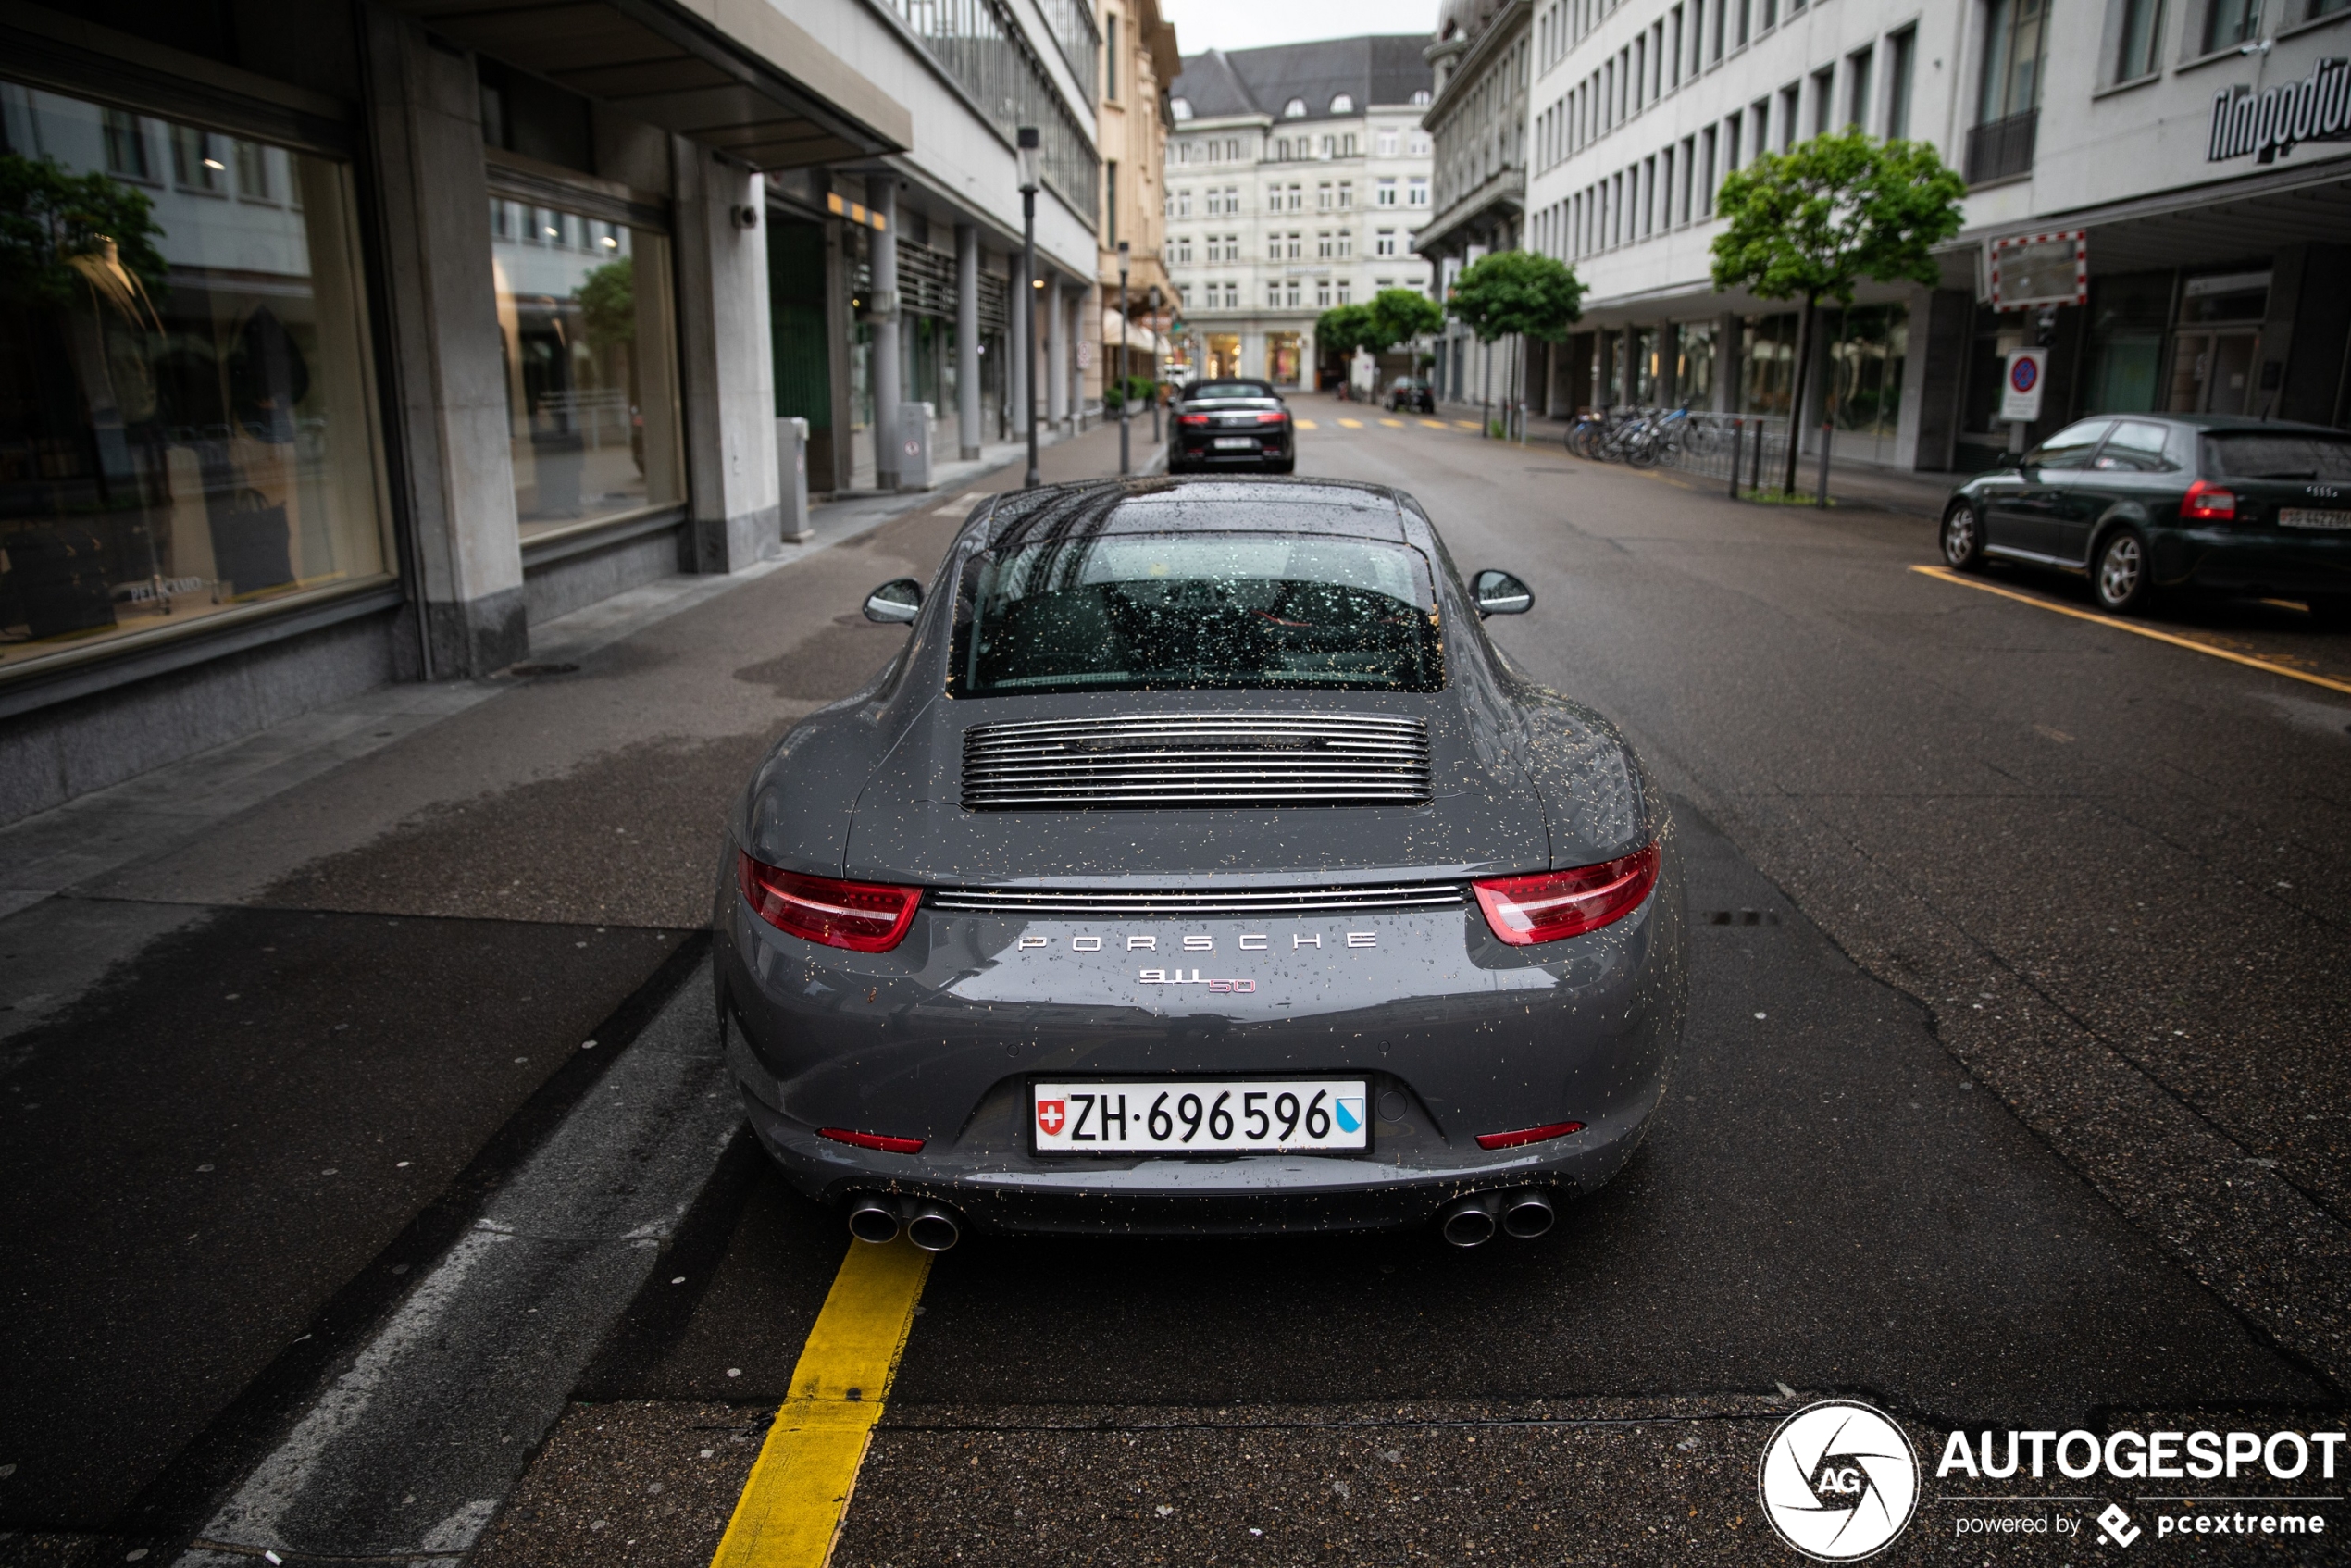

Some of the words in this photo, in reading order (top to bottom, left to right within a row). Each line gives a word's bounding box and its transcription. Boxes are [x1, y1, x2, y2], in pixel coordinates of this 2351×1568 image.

[1018, 931, 1376, 952] PORSCHE
[1139, 968, 1203, 984] 911
[1209, 979, 1256, 993] 50
